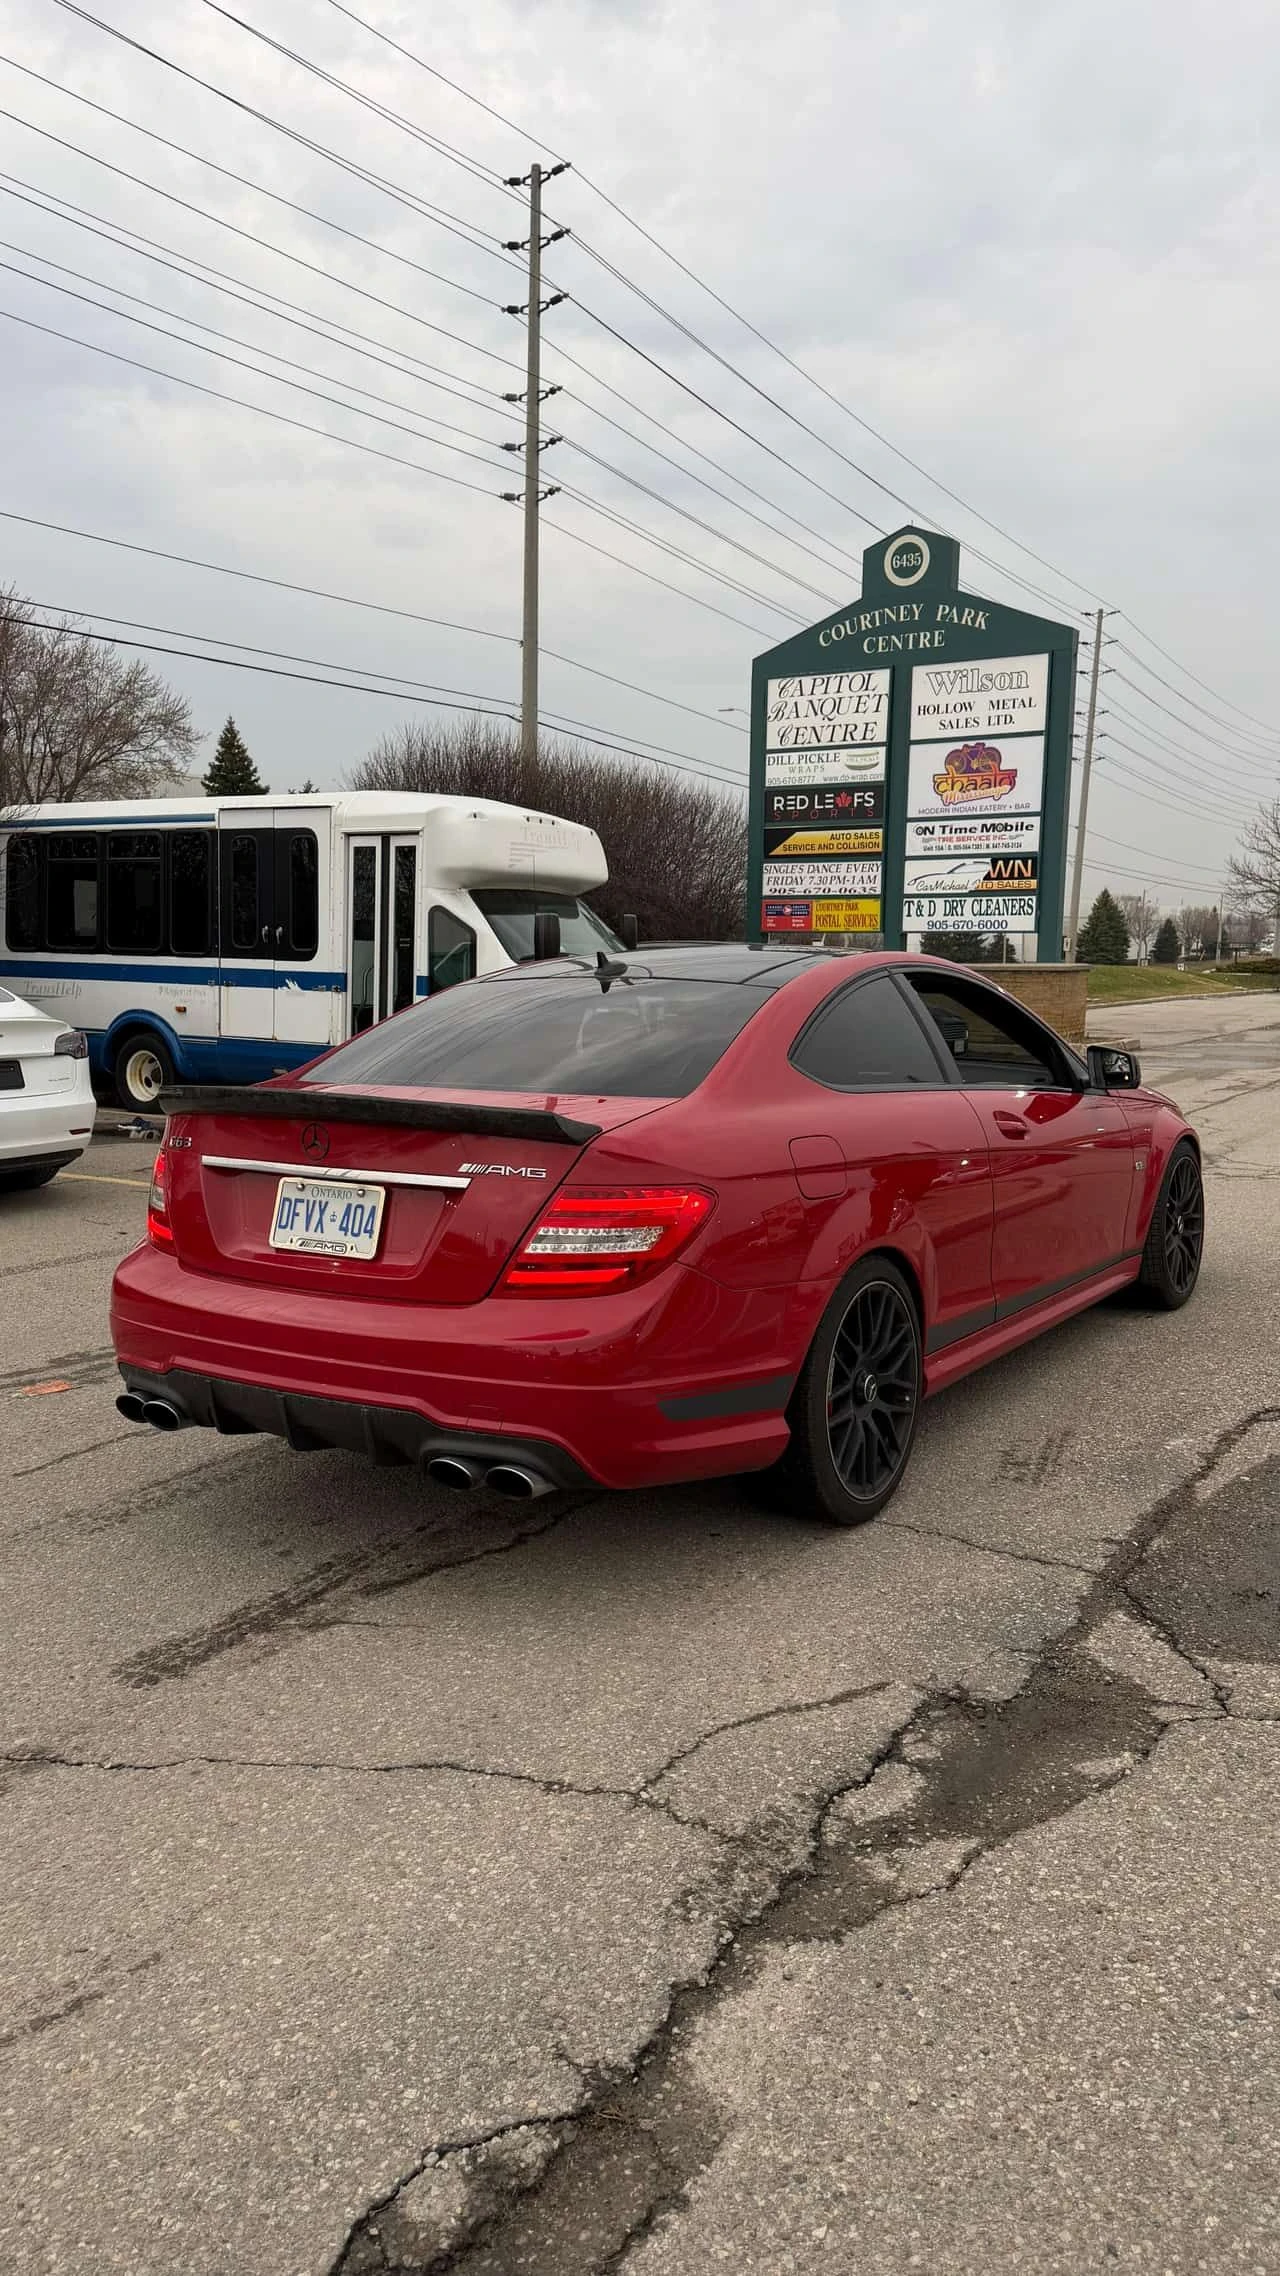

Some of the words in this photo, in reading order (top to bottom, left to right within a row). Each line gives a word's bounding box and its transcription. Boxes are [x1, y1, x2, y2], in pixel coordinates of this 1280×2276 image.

[892, 552, 922, 569] 6435
[818, 602, 924, 648] COURTNEY
[935, 603, 991, 631] PARK
[862, 629, 946, 654] CENTRE
[777, 672, 878, 699] CAPITOL
[925, 667, 1030, 697] Wilson
[767, 693, 889, 723] BANQUET
[916, 701, 976, 717] HOLLOW
[988, 696, 1037, 712] METAL
[938, 715, 980, 731] SALES
[987, 713, 1016, 727] LTD.
[777, 721, 878, 747] CENTRE
[767, 754, 795, 767] DILL
[798, 752, 841, 765] PICKLE
[788, 764, 825, 775] WRAPS
[773, 795, 809, 811] RED
[814, 791, 875, 809] LEFS
[773, 806, 874, 821] SPORTS
[918, 806, 950, 815] MODERN
[951, 805, 978, 813] INDIAN
[979, 803, 1007, 812] EATERY
[830, 832, 852, 841] AUTO
[853, 831, 881, 840] SALES
[939, 823, 978, 835] Time
[956, 834, 991, 843] SERVICE
[782, 842, 816, 852] SERVICE
[817, 841, 835, 851] AND
[836, 840, 881, 850] COLLISION
[806, 863, 843, 874] DANCE
[845, 862, 882, 873] EVERY
[766, 875, 805, 887] FRIDAY
[997, 880, 1032, 889] SALES
[768, 887, 878, 895] 905-670-0635
[815, 903, 843, 912] COURTNEY
[904, 900, 915, 917] T
[915, 900, 924, 918] &
[927, 900, 936, 917] D
[943, 898, 967, 917] DRY
[971, 897, 1034, 917] CLEANERS
[815, 914, 841, 929] POSTAL
[843, 913, 879, 928] SERVICES
[926, 919, 1009, 930] 905-670-6000
[485, 1165, 547, 1179] AMG
[311, 1186, 353, 1200] ONTARIO
[277, 1196, 329, 1235] DFVX
[338, 1202, 377, 1240] 404
[313, 1242, 345, 1254] AMG
